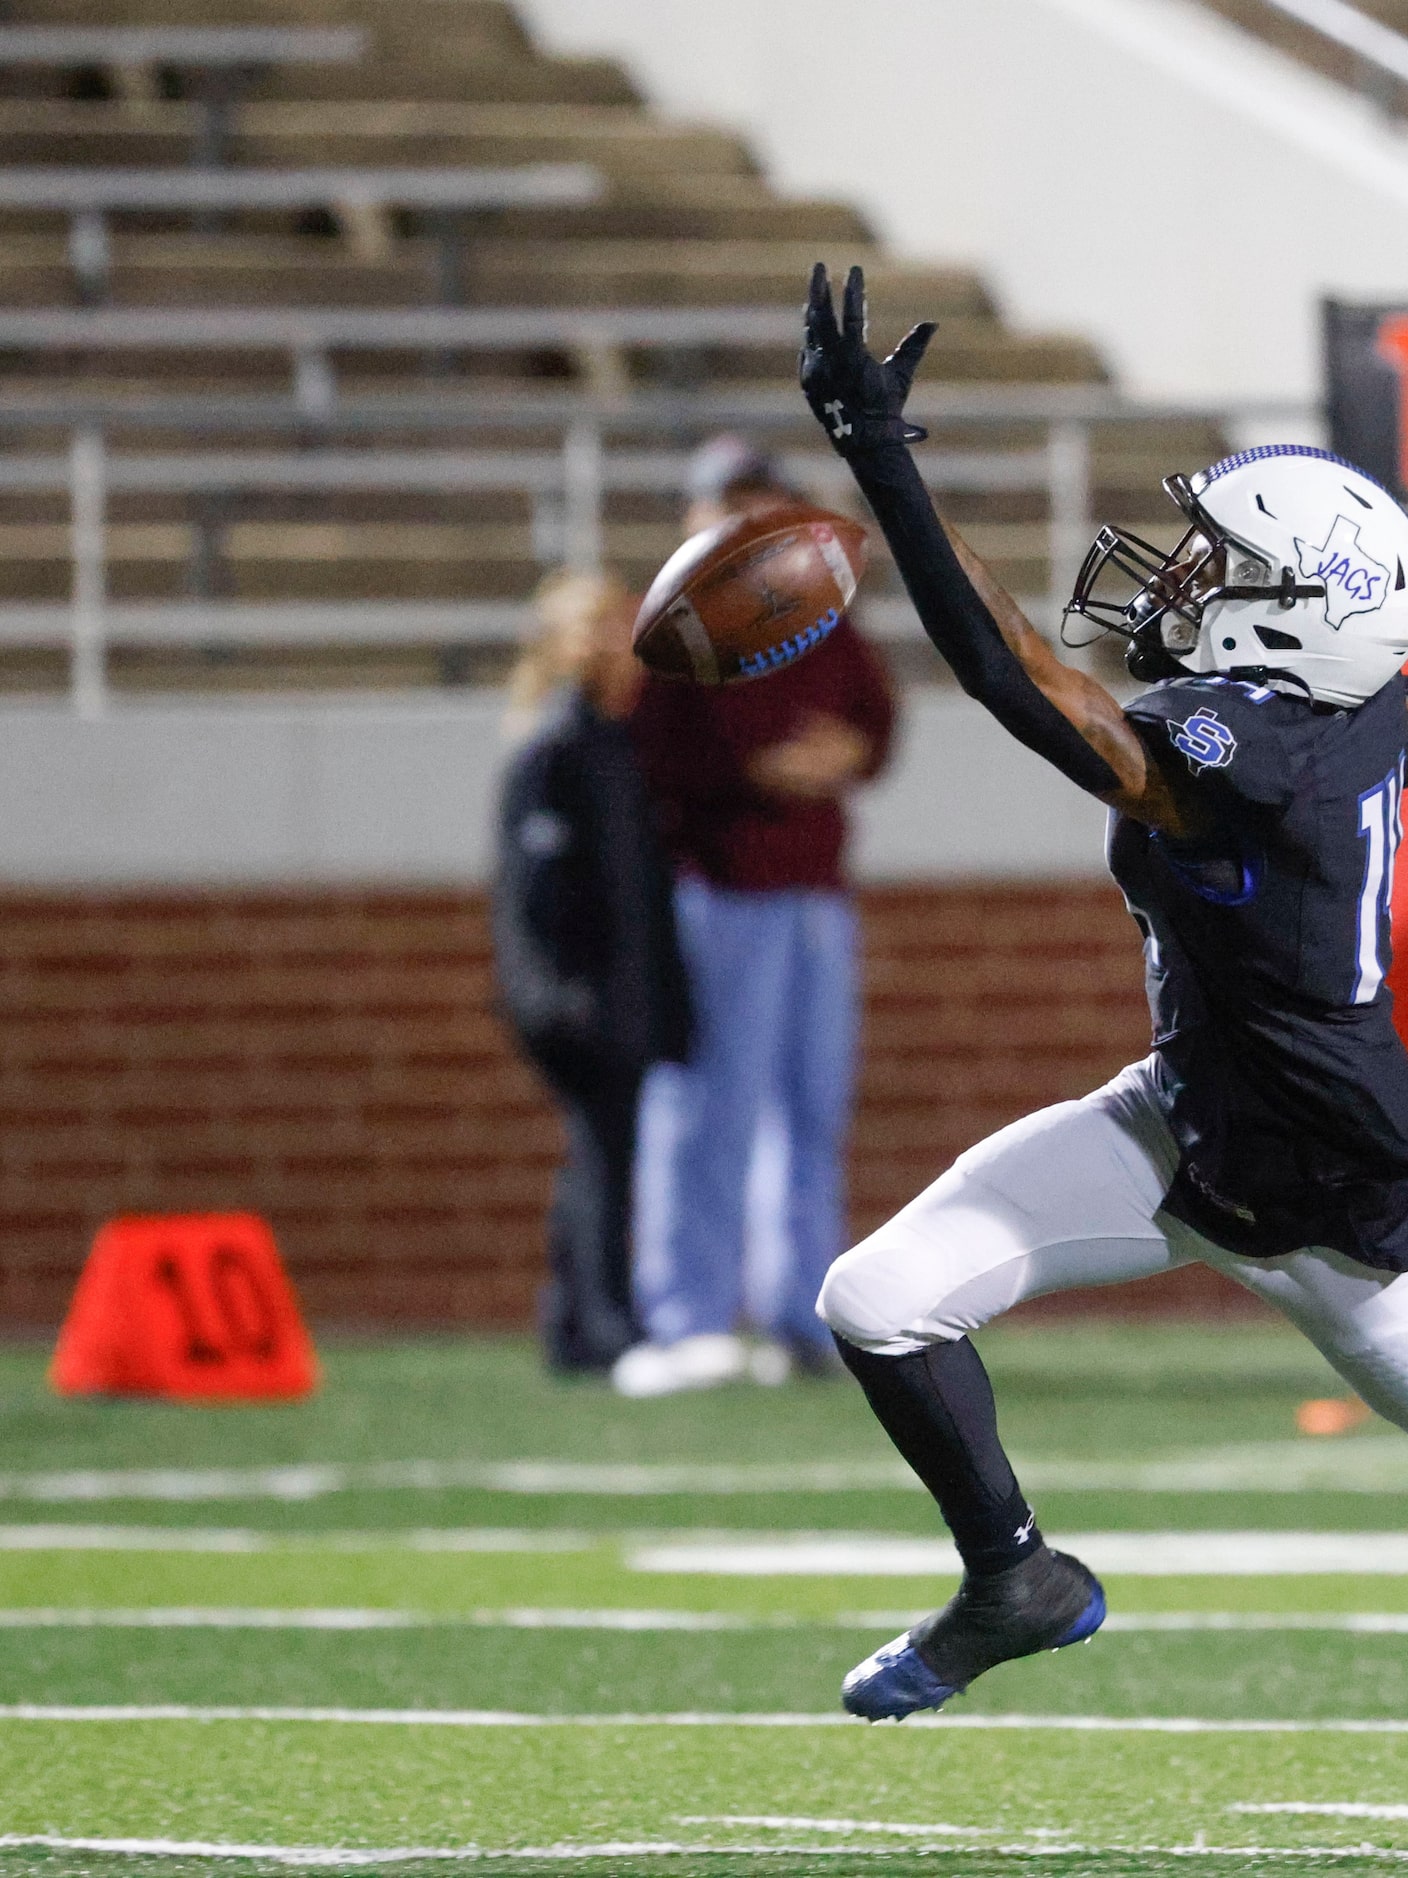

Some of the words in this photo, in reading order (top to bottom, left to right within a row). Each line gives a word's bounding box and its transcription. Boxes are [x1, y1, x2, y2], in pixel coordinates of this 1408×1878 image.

[1317, 552, 1381, 600] JAGS
[1175, 715, 1234, 764] S
[155, 1245, 279, 1367] 10
